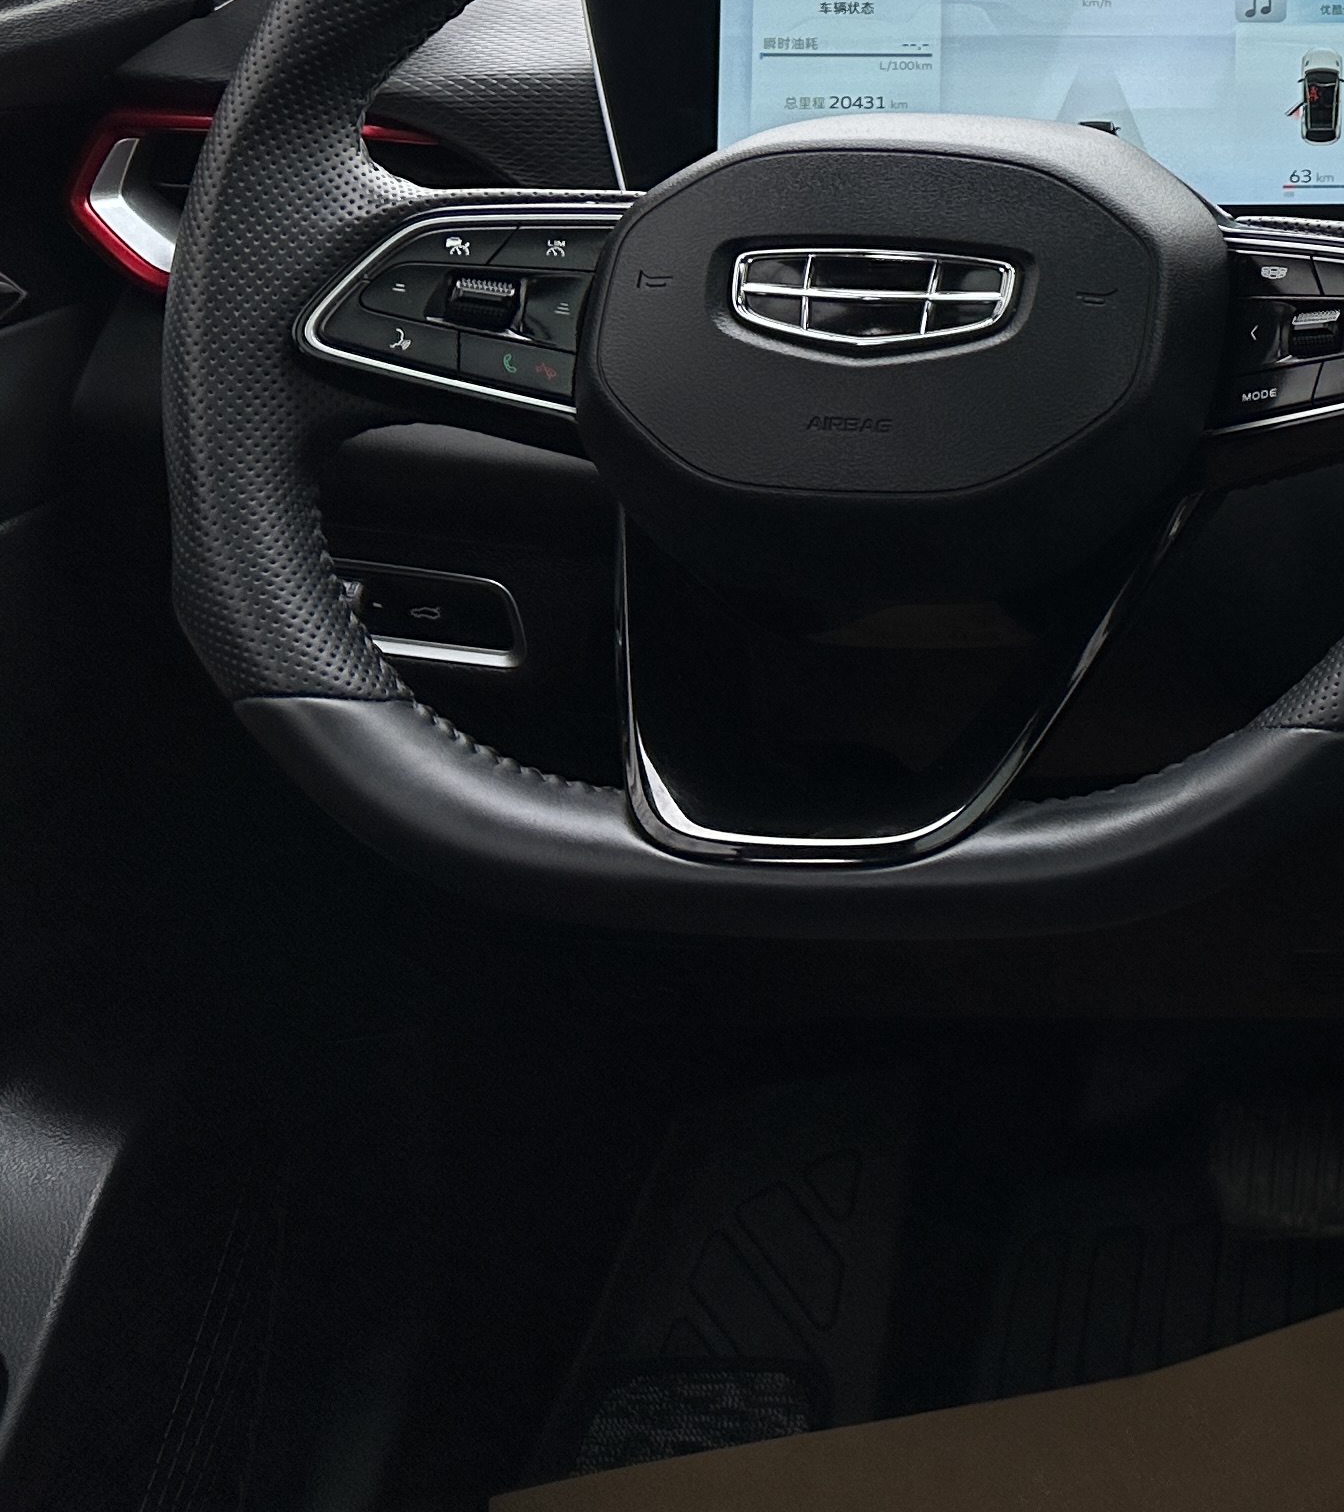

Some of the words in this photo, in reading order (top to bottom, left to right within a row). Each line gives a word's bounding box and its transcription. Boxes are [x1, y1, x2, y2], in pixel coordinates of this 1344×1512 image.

[819, 2, 875, 15] 车辆状态
[763, 37, 819, 50] 瞬时油耗
[879, 60, 933, 71] L/100km
[784, 96, 825, 109] 总里程
[829, 96, 885, 109] 20431
[890, 99, 908, 109] km
[1289, 169, 1312, 184] 63
[1316, 172, 1334, 183] km
[1241, 388, 1277, 402] MODE
[806, 415, 893, 433] AIRBAG
